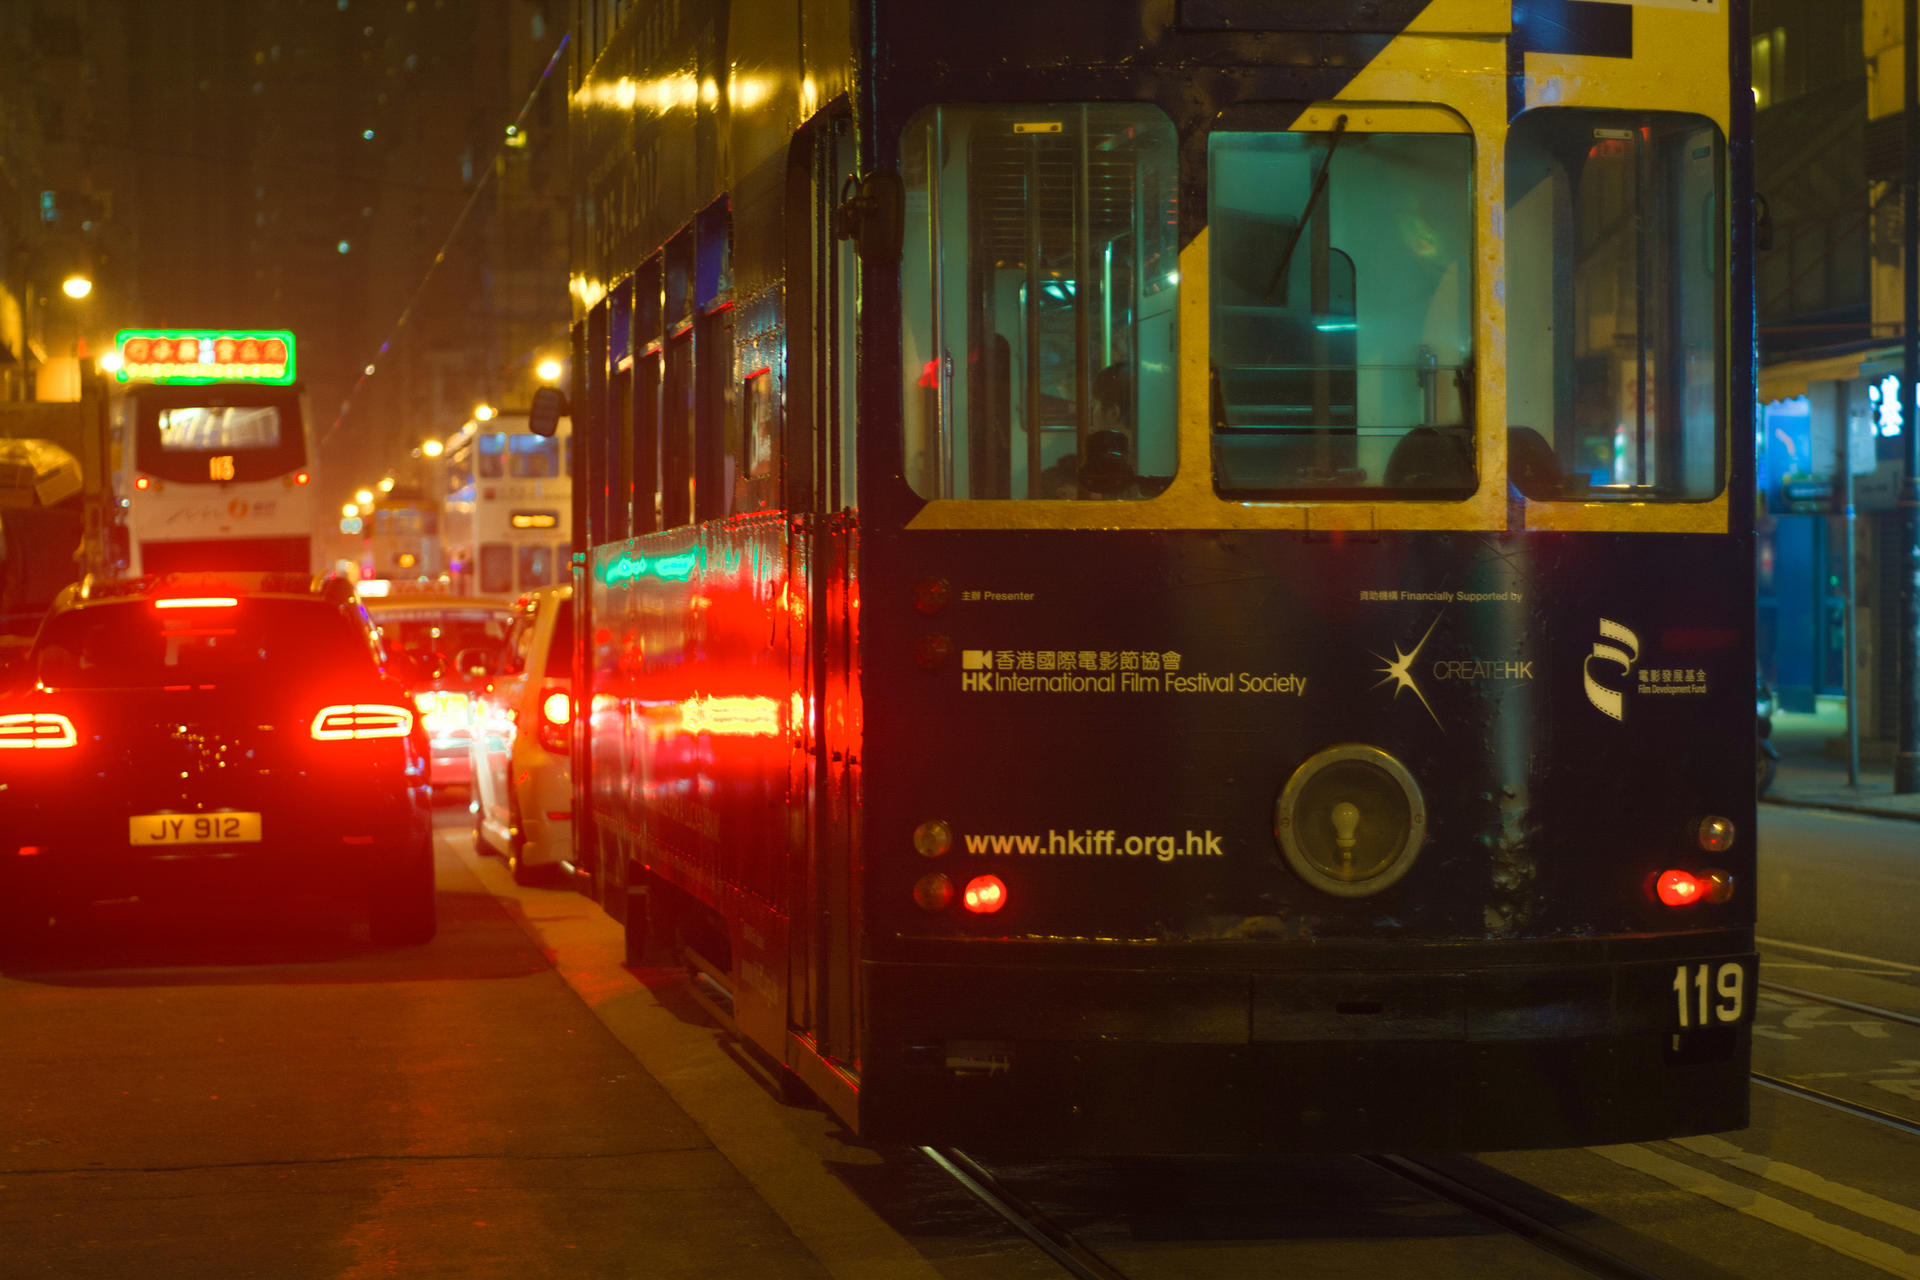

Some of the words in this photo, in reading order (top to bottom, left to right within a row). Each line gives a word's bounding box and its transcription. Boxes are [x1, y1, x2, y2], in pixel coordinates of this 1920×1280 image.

[984, 591, 1035, 601] Presenter
[1400, 591, 1454, 603] Financially
[1456, 591, 1509, 603] Supported
[1511, 591, 1524, 603] by
[996, 650, 1182, 671] 香港國際電影節協會
[1121, 672, 1160, 692] Film
[1165, 672, 1234, 693] Festival
[1238, 672, 1307, 697] Society
[1638, 669, 1706, 683] 電影發展基金
[1638, 684, 1652, 694] Film
[1652, 684, 1691, 696] Development
[1691, 684, 1706, 694] Fund
[150, 820, 184, 841] JY
[194, 817, 241, 839] 912
[964, 829, 1223, 862] www.hkiff.org.hk
[1672, 962, 1744, 1027] 119
